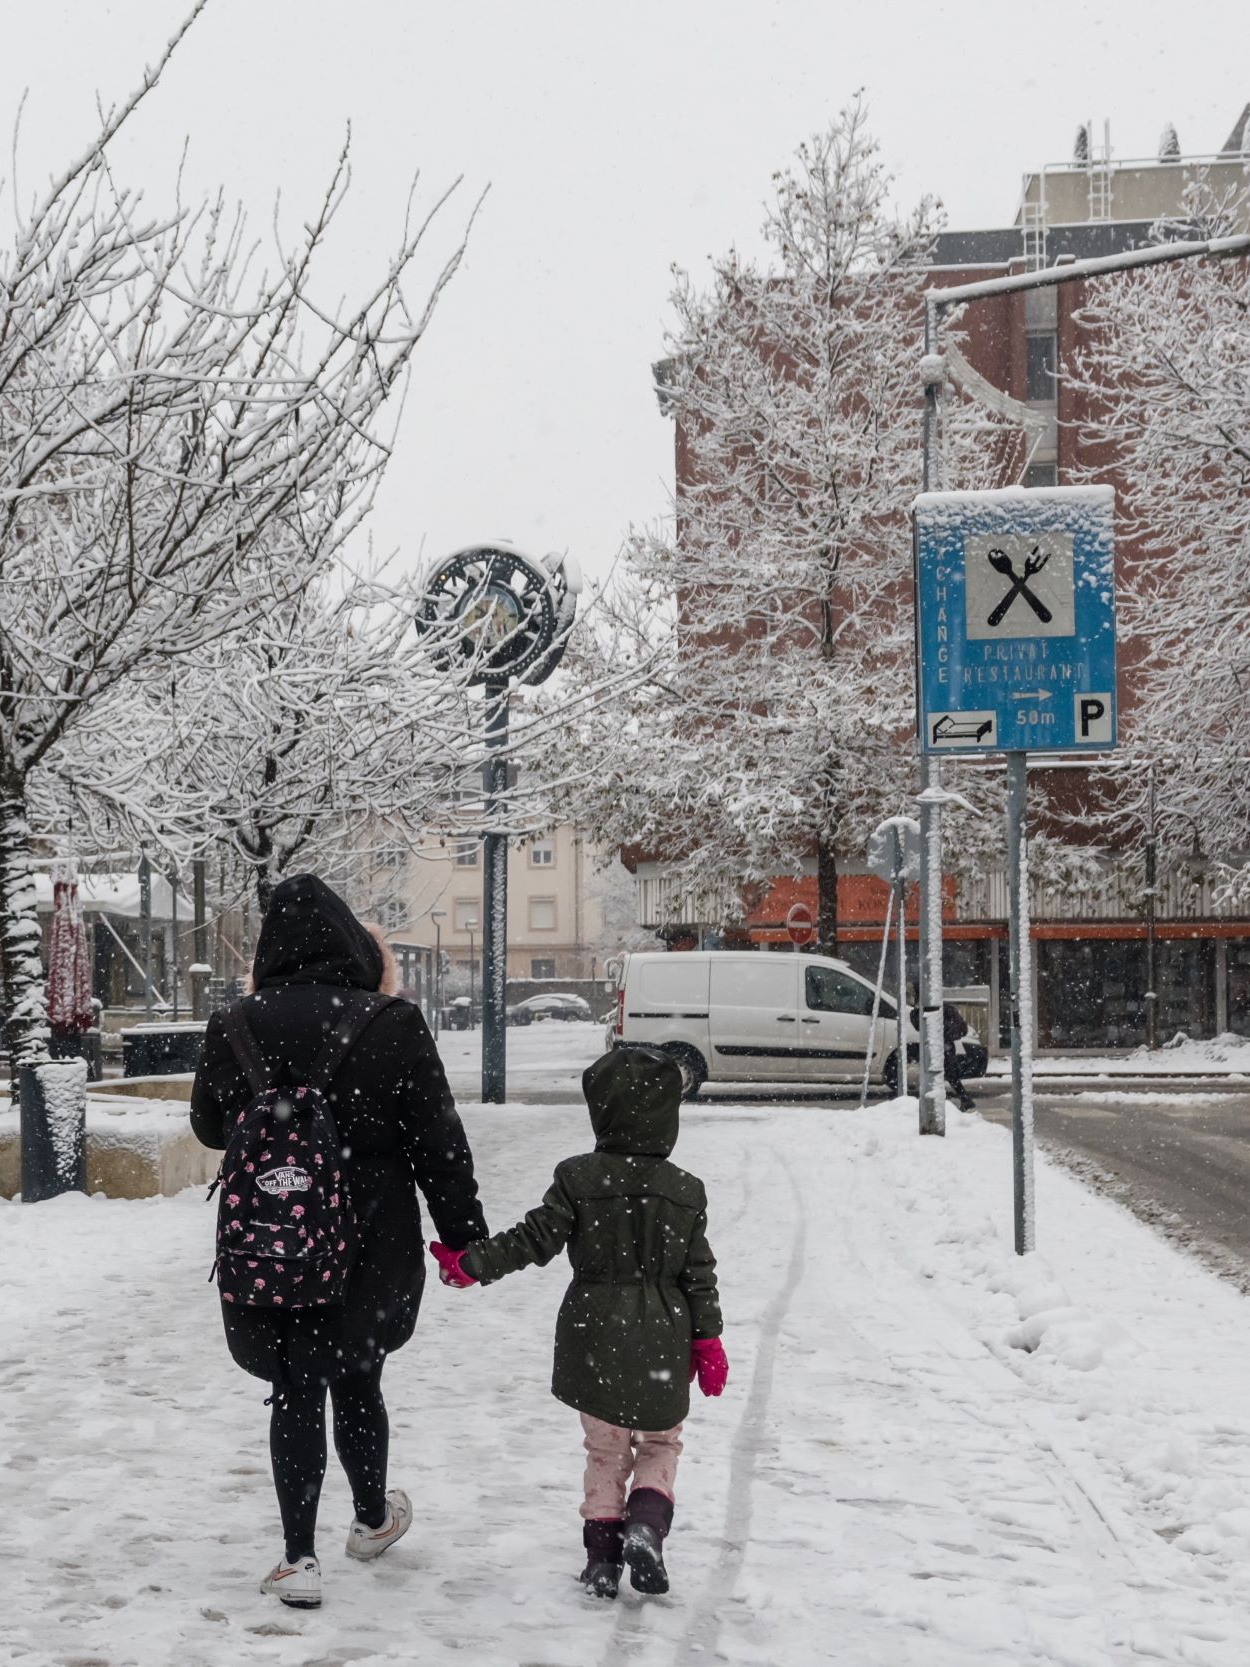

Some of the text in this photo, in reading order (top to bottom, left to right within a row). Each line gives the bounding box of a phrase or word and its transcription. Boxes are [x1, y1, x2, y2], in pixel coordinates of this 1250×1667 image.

[964, 663, 1084, 684] RESTAURANT
[1016, 709, 1055, 725] 50m
[1081, 699, 1105, 736] P
[274, 1171, 296, 1180] VANS
[279, 1178, 292, 1187] THE
